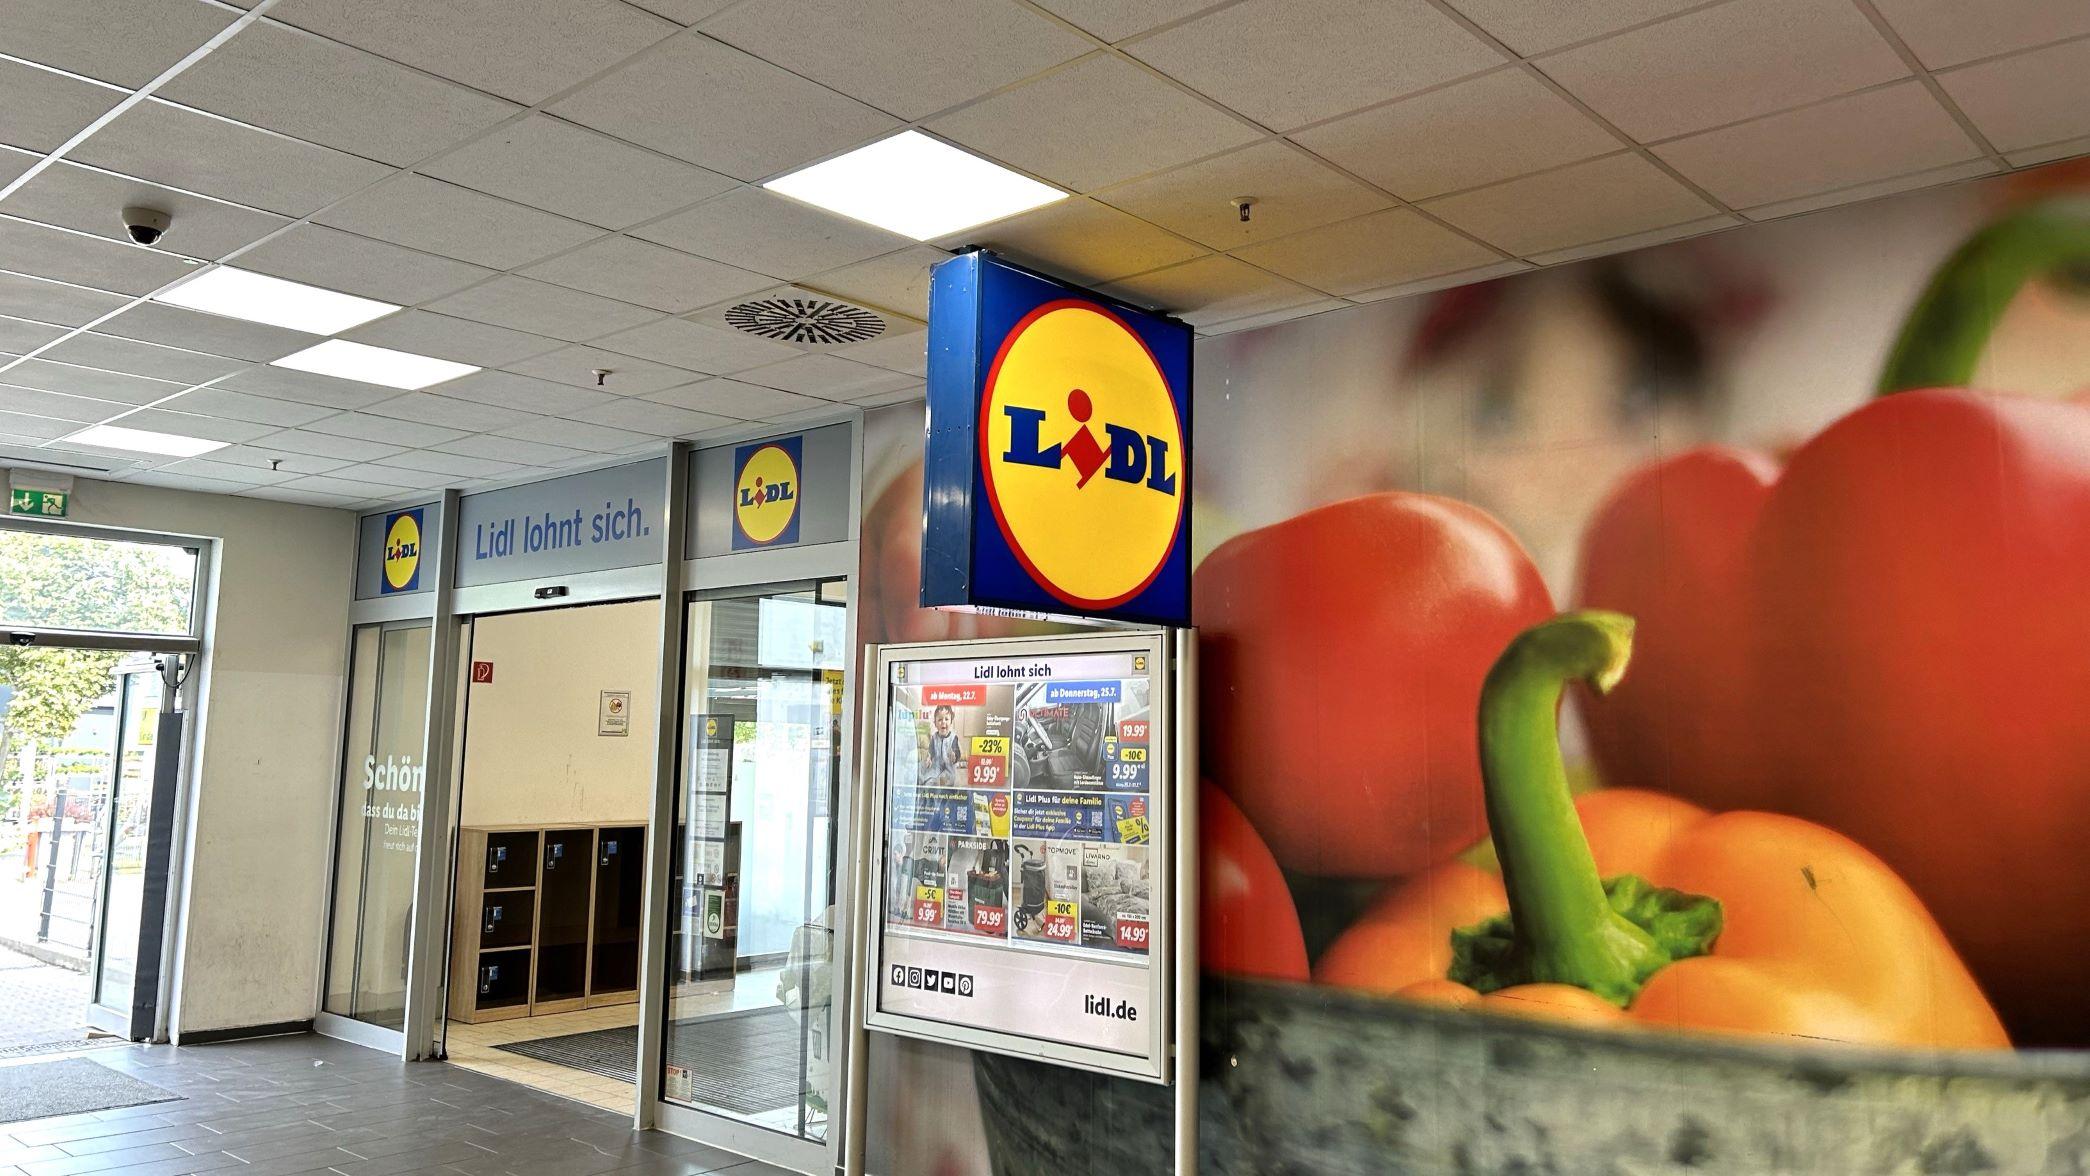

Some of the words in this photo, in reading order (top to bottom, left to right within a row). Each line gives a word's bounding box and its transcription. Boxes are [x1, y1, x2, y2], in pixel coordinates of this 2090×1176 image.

[476, 519, 515, 560] Lidl
[523, 509, 583, 553] lohnt
[591, 498, 649, 543] sich.
[974, 665, 993, 679] Lidl
[997, 665, 1025, 678] lohnt
[1029, 664, 1051, 677] sich
[930, 691, 938, 700] ab
[1050, 688, 1058, 698] ab
[1059, 688, 1100, 699] Donnerstag,
[1101, 687, 1116, 697] 25.7.
[979, 739, 1002, 753] -23%
[1125, 750, 1142, 760] -10€
[1025, 795, 1036, 803] Lidl
[1037, 796, 1050, 804] Plus
[1052, 796, 1060, 804] für
[1061, 796, 1078, 805] deine
[1079, 797, 1102, 806] Familie
[361, 801, 380, 818] dass
[382, 802, 394, 819] du
[396, 803, 408, 820] da
[410, 804, 421, 821] bi
[385, 823, 398, 835] Dein
[957, 841, 987, 850] PARKSIDE
[1085, 852, 1110, 860] LIVARNO
[1055, 903, 1071, 914] -10€
[1084, 995, 1137, 1021] lidl.de
